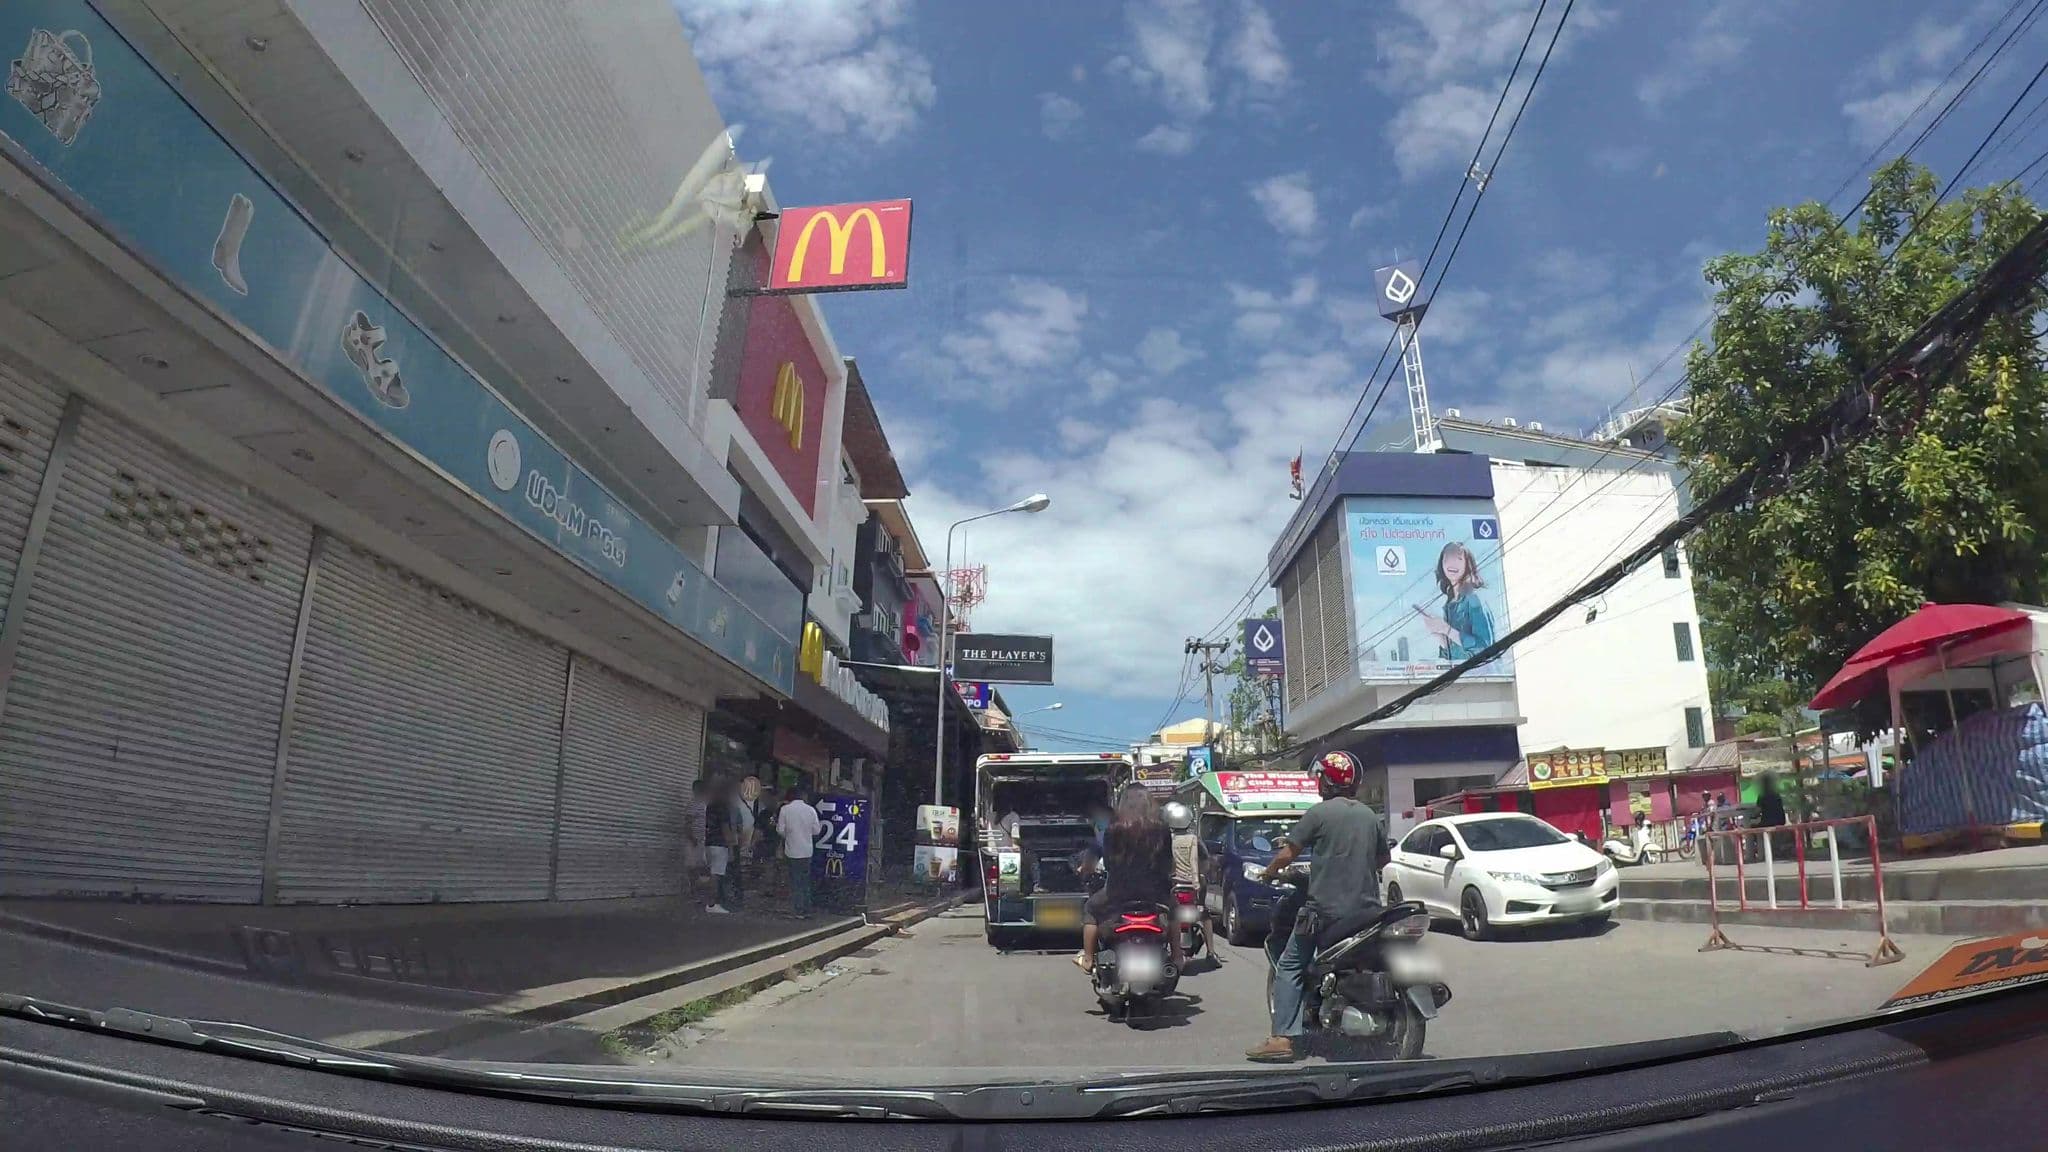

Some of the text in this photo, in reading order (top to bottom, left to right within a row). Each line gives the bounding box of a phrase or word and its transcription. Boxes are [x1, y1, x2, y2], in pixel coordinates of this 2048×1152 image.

[962, 649, 1046, 660] THE PLAYER'S
[815, 820, 859, 852] 24
